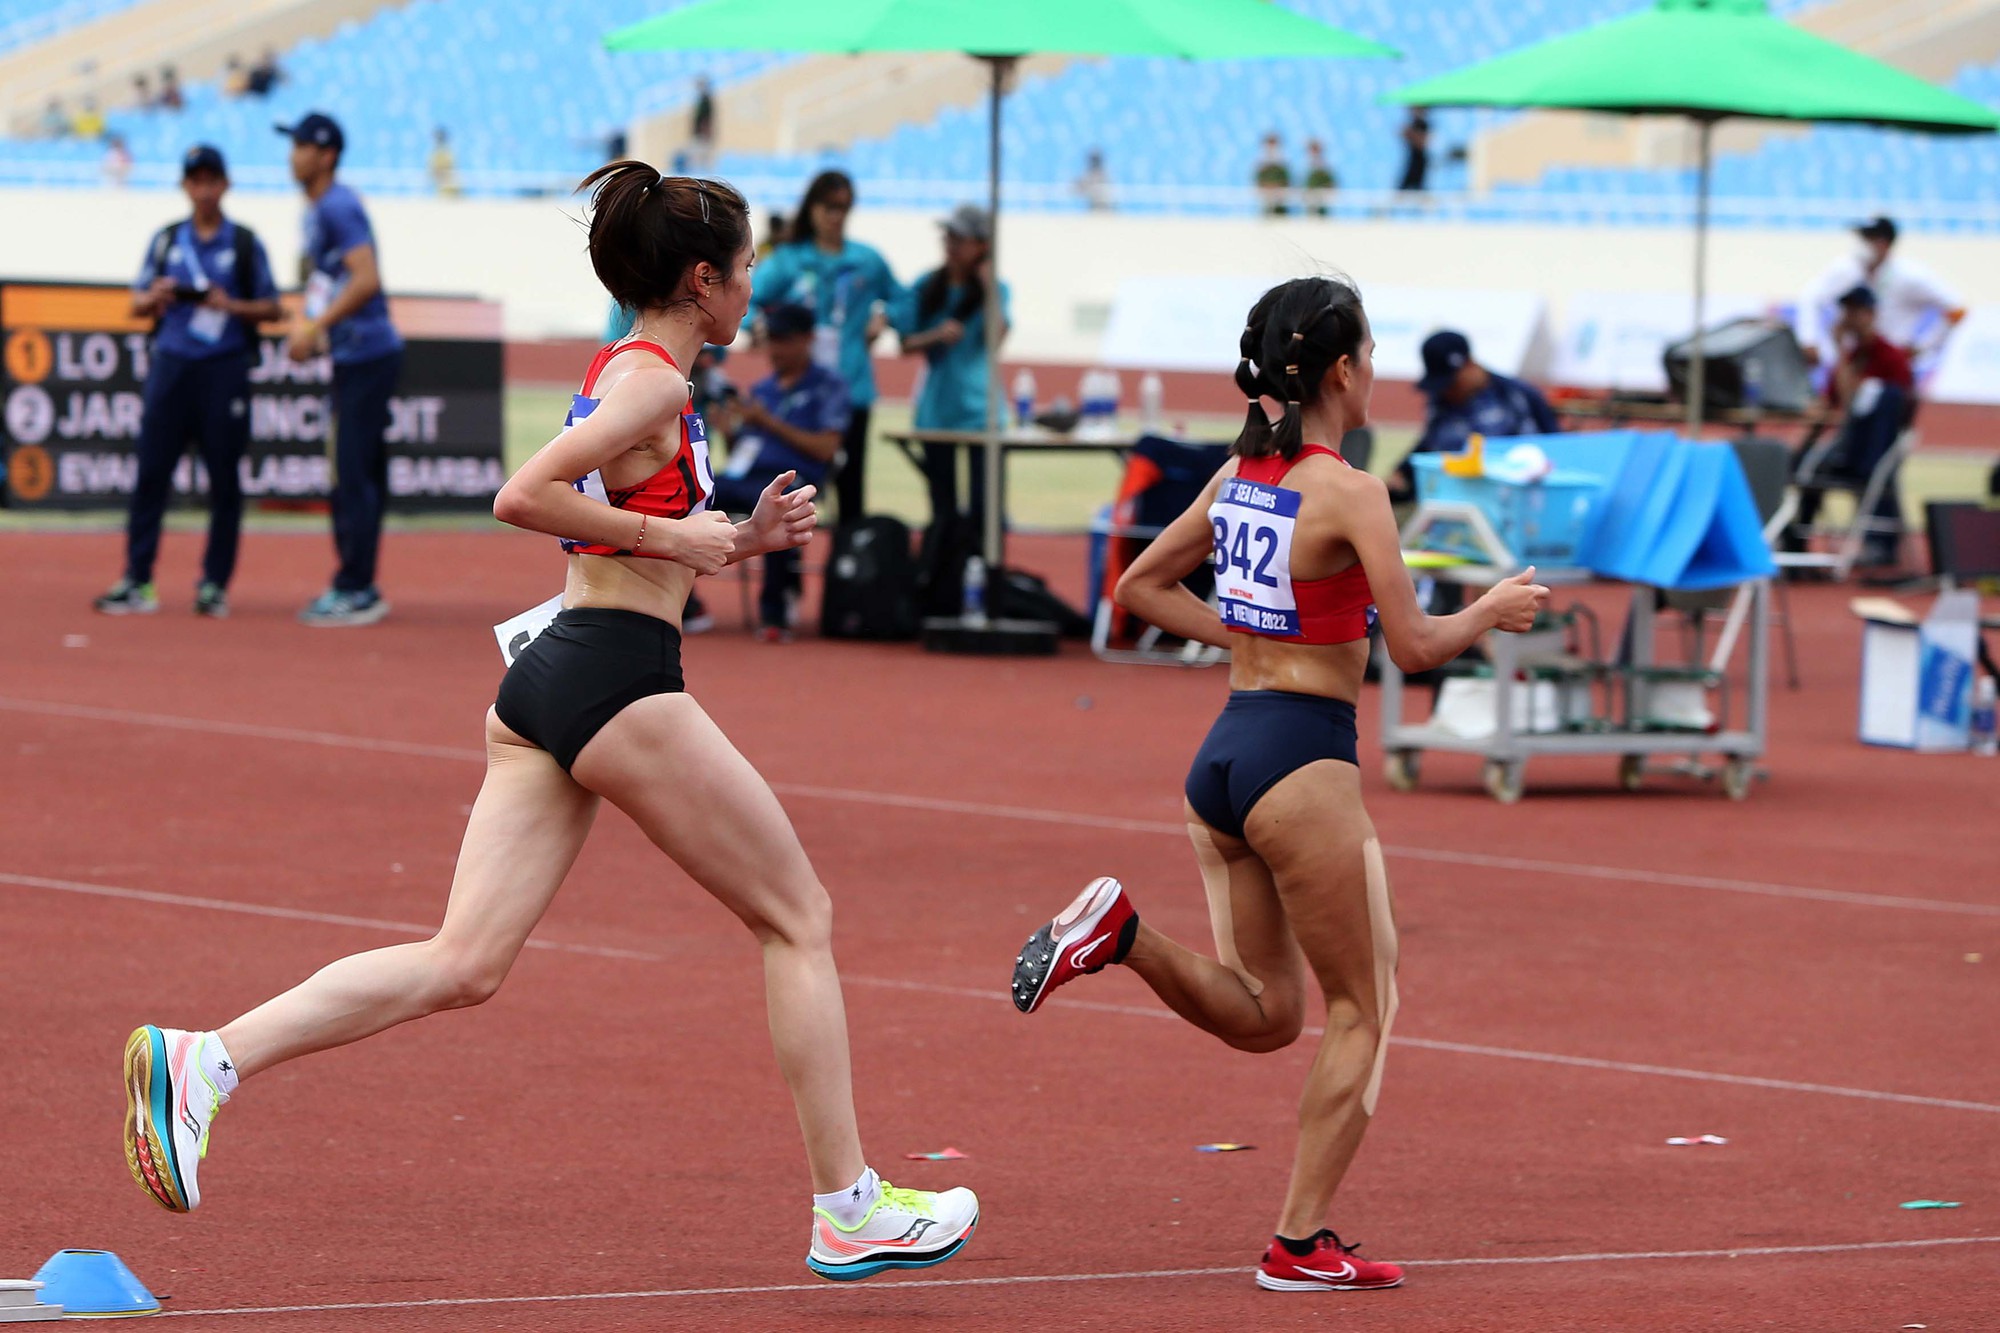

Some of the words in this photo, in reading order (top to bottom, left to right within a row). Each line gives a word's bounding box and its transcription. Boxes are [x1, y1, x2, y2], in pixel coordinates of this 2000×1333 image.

[56, 332, 119, 381] LO
[1234, 485, 1253, 503] SEA
[1249, 487, 1277, 510] Games
[1212, 516, 1278, 588] 842
[1260, 611, 1289, 631] 2022
